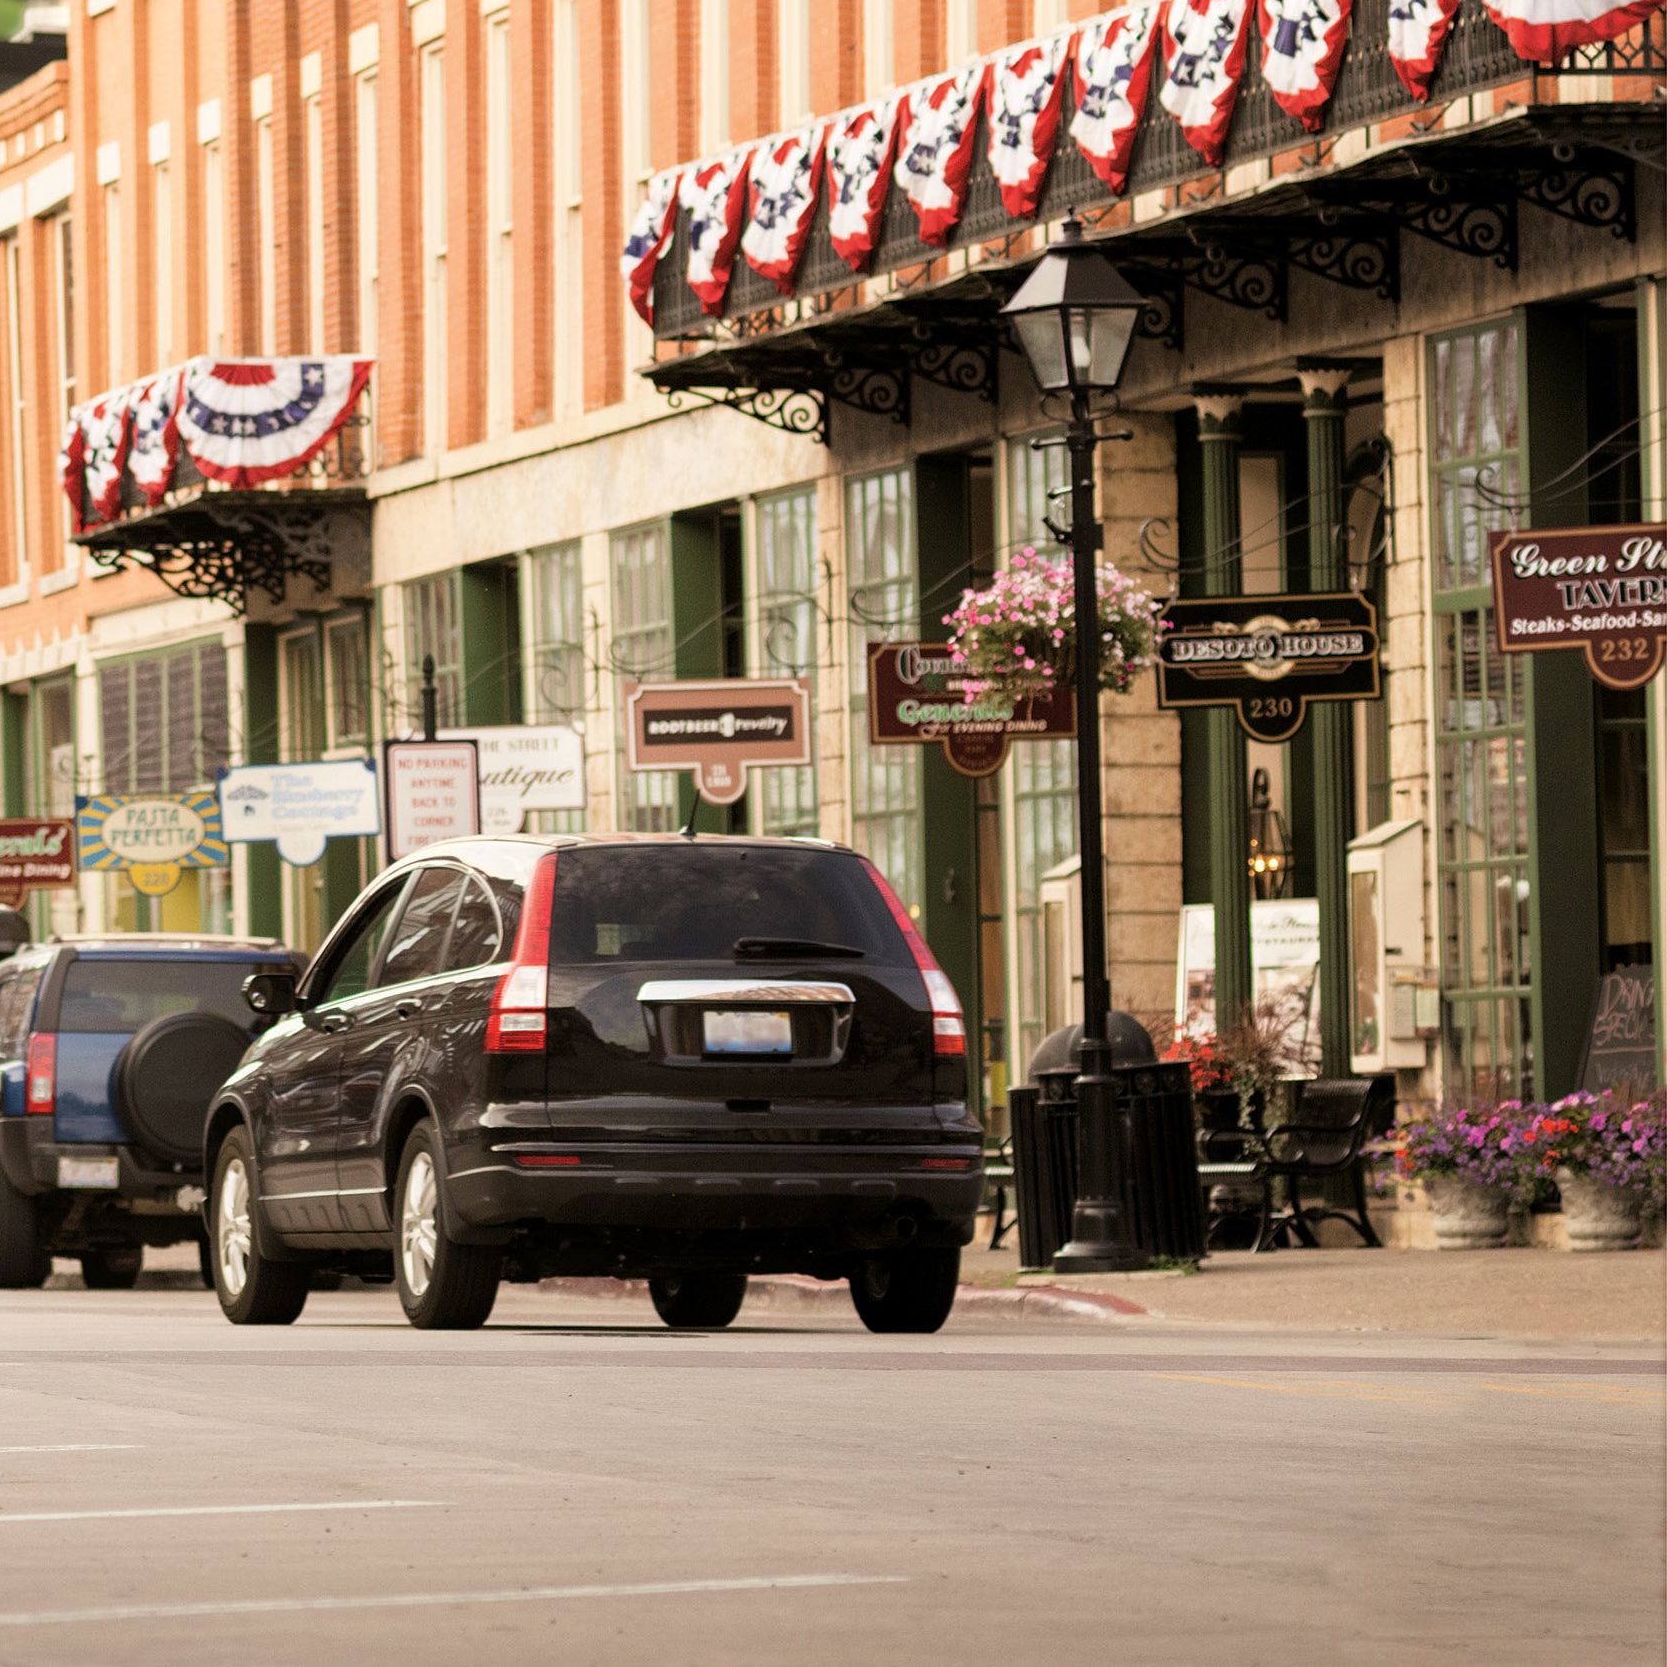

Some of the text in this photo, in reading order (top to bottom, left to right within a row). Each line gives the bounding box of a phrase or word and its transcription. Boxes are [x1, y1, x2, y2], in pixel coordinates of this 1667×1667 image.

[1510, 543, 1609, 578] Green
[1171, 633, 1364, 662] DESOTO HOUSE
[1601, 637, 1650, 663] 232
[1249, 697, 1293, 719] 230
[953, 720, 1004, 734] EVENING
[1005, 718, 1048, 733] DINING
[481, 737, 560, 752] HE STREET
[398, 757, 467, 770] NO PARKING
[411, 777, 456, 789] ANYTIME
[481, 765, 575, 797] utique
[410, 796, 456, 809] BACK TO
[126, 807, 181, 828] PASTA
[412, 815, 454, 828] CORNER
[110, 827, 197, 848] PERFETTA
[23, 862, 72, 880] Dining
